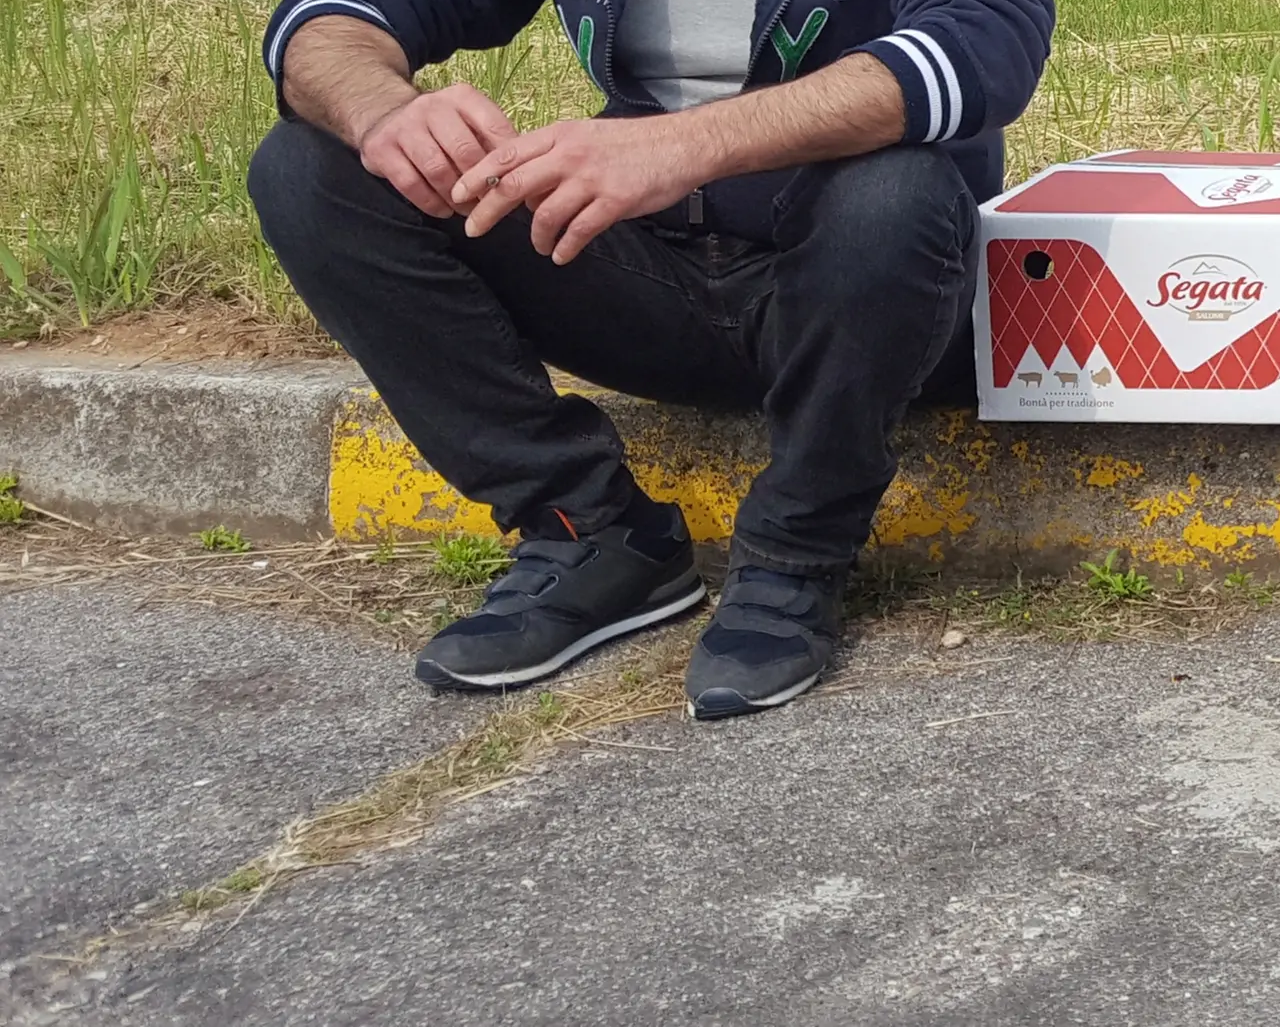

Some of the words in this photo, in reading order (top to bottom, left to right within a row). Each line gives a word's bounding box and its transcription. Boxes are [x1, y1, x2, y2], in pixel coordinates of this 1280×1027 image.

[1207, 174, 1260, 202] Segata
[1146, 272, 1265, 310] Segata
[1019, 397, 1047, 407] Bontà
[1049, 399, 1065, 410] per
[1067, 398, 1114, 408] tradizione
